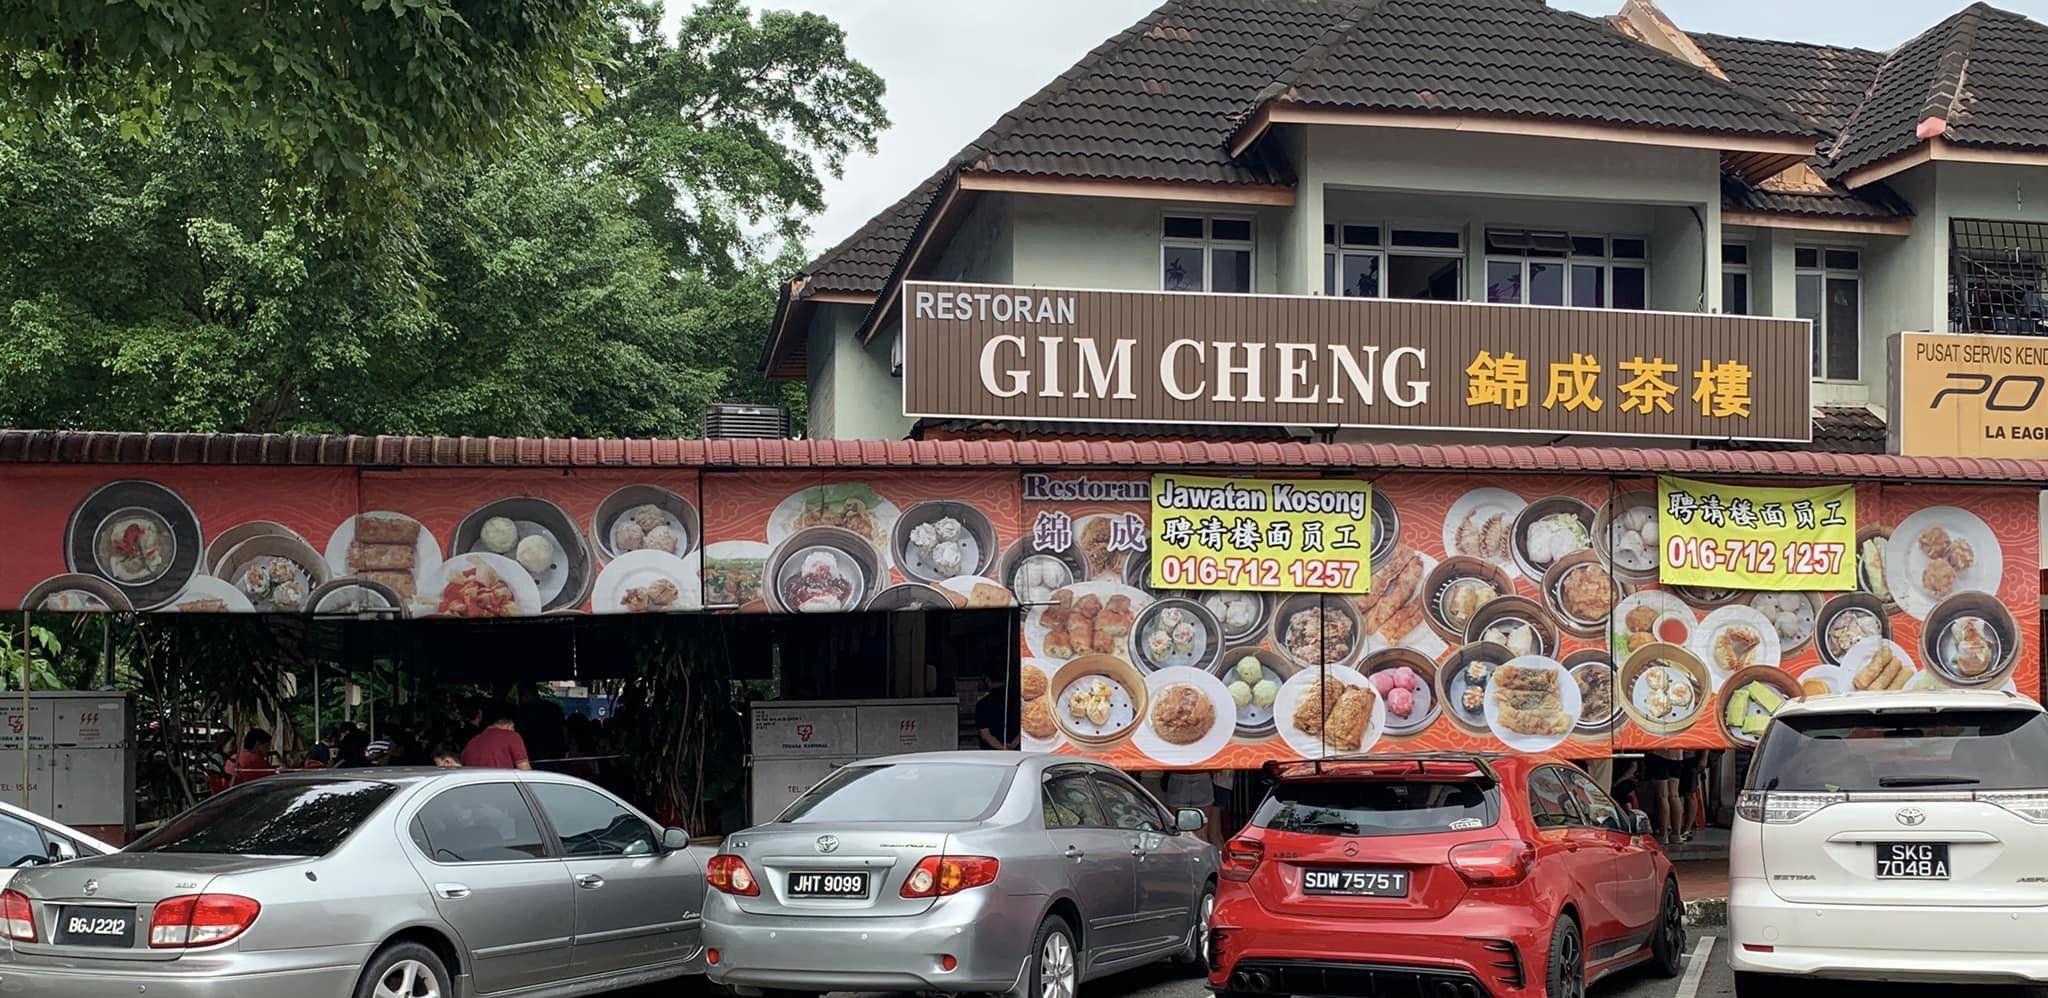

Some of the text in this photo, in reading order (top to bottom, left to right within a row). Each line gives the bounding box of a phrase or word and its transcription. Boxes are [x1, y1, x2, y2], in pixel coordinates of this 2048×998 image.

[915, 291, 1075, 324] RESTORAN
[1916, 342, 1960, 362] PUSAT
[1963, 344, 2012, 365] SERVIS
[979, 335, 1431, 407] GIM CHENG
[1465, 350, 1752, 417] 錦成茶樓
[1985, 425, 2006, 440] LA
[1023, 473, 1150, 500] Restoran
[1158, 479, 1365, 520] Jawatan Kosong
[1667, 490, 1847, 530] 聘请楼面员工
[1162, 515, 1360, 552] 聘请楼面员工
[1667, 534, 1846, 575] 016-712 1257
[1161, 555, 1360, 589] 016-712 1257
[1891, 844, 1932, 861] SKG
[793, 874, 862, 893] JHT 9099
[1305, 872, 1340, 889] SDW
